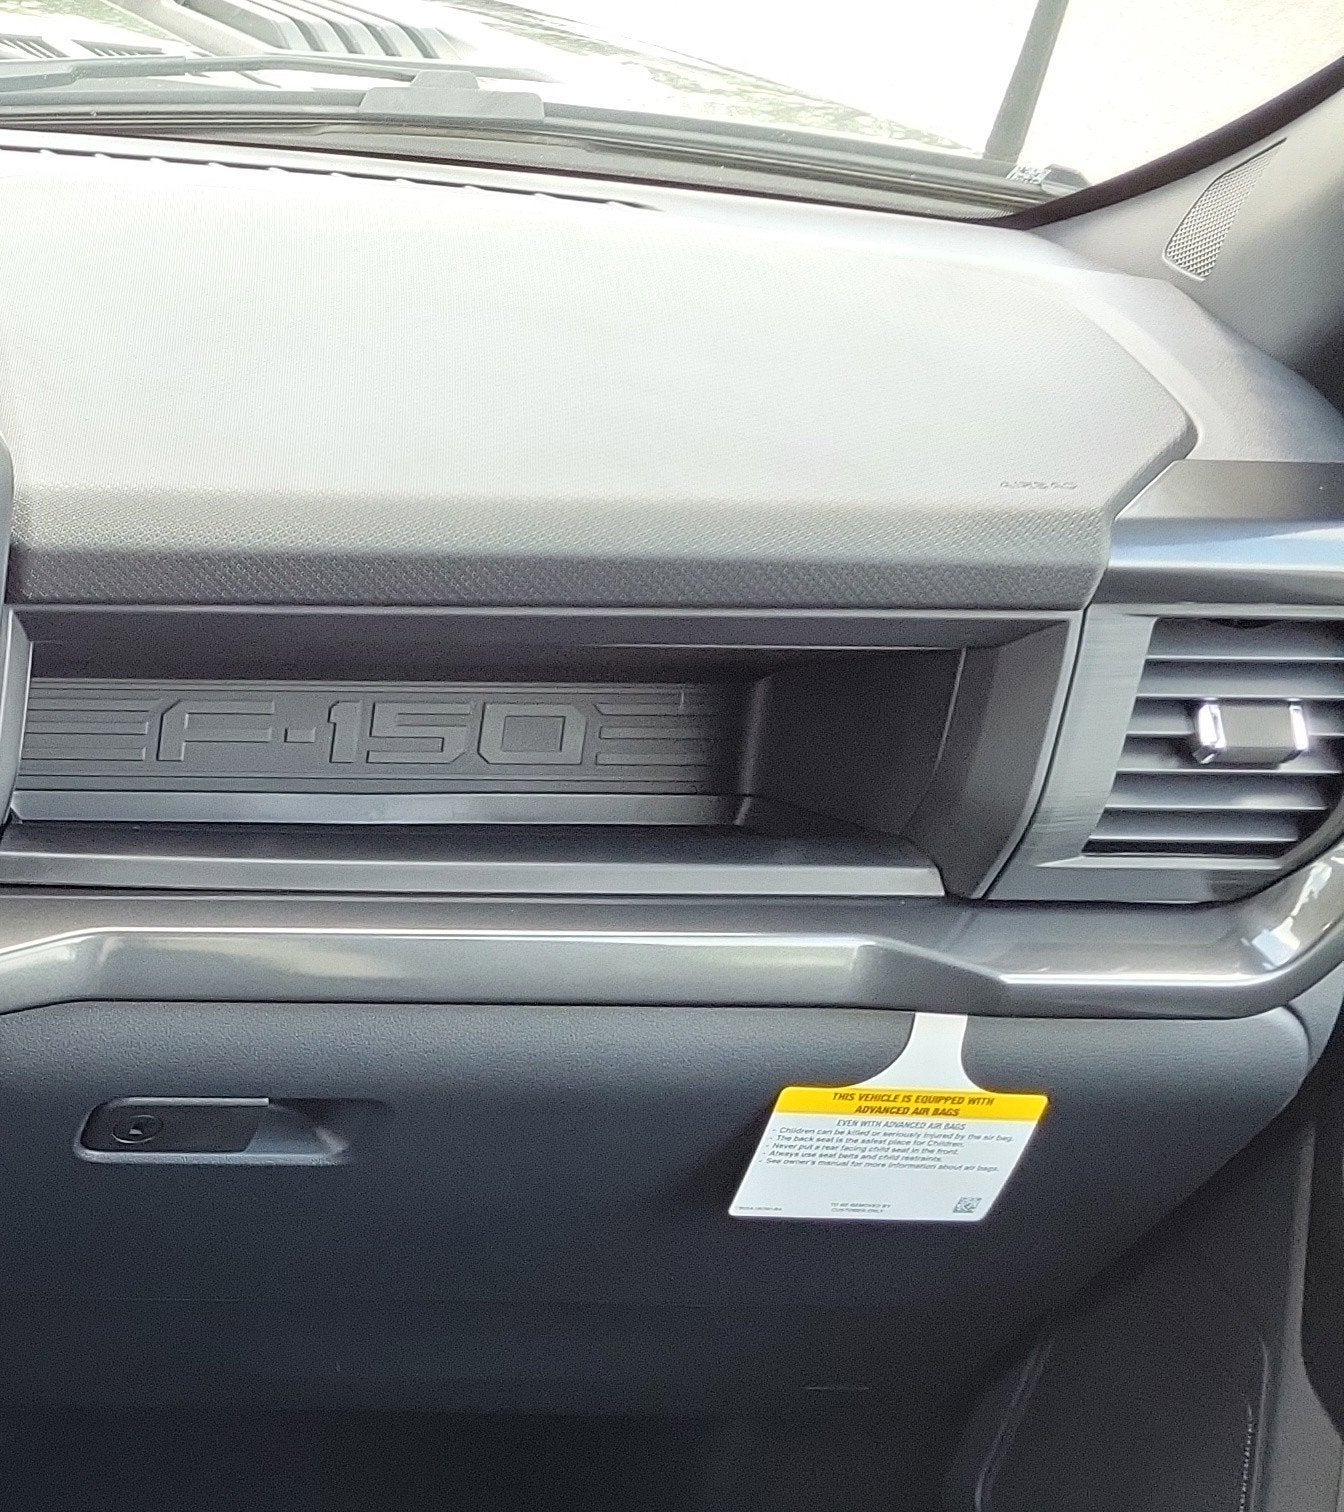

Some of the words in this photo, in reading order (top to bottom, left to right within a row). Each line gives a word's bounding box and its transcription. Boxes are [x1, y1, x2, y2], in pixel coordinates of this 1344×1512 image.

[157, 699, 590, 766] F-150
[832, 1092, 856, 1101] THIS
[858, 1093, 900, 1103] VEHICLE
[901, 1095, 911, 1103] IS
[914, 1095, 964, 1105] EQUIPPED
[967, 1096, 995, 1106] WITH
[855, 1106, 910, 1115] ADVANCED
[911, 1107, 930, 1115] AIR
[931, 1107, 960, 1117] BAGS
[836, 1119, 858, 1127] EVEN
[862, 1120, 881, 1128] WITH
[882, 1121, 926, 1129] ADVANCED
[927, 1122, 944, 1130] AIR
[944, 1123, 966, 1131] BAGS
